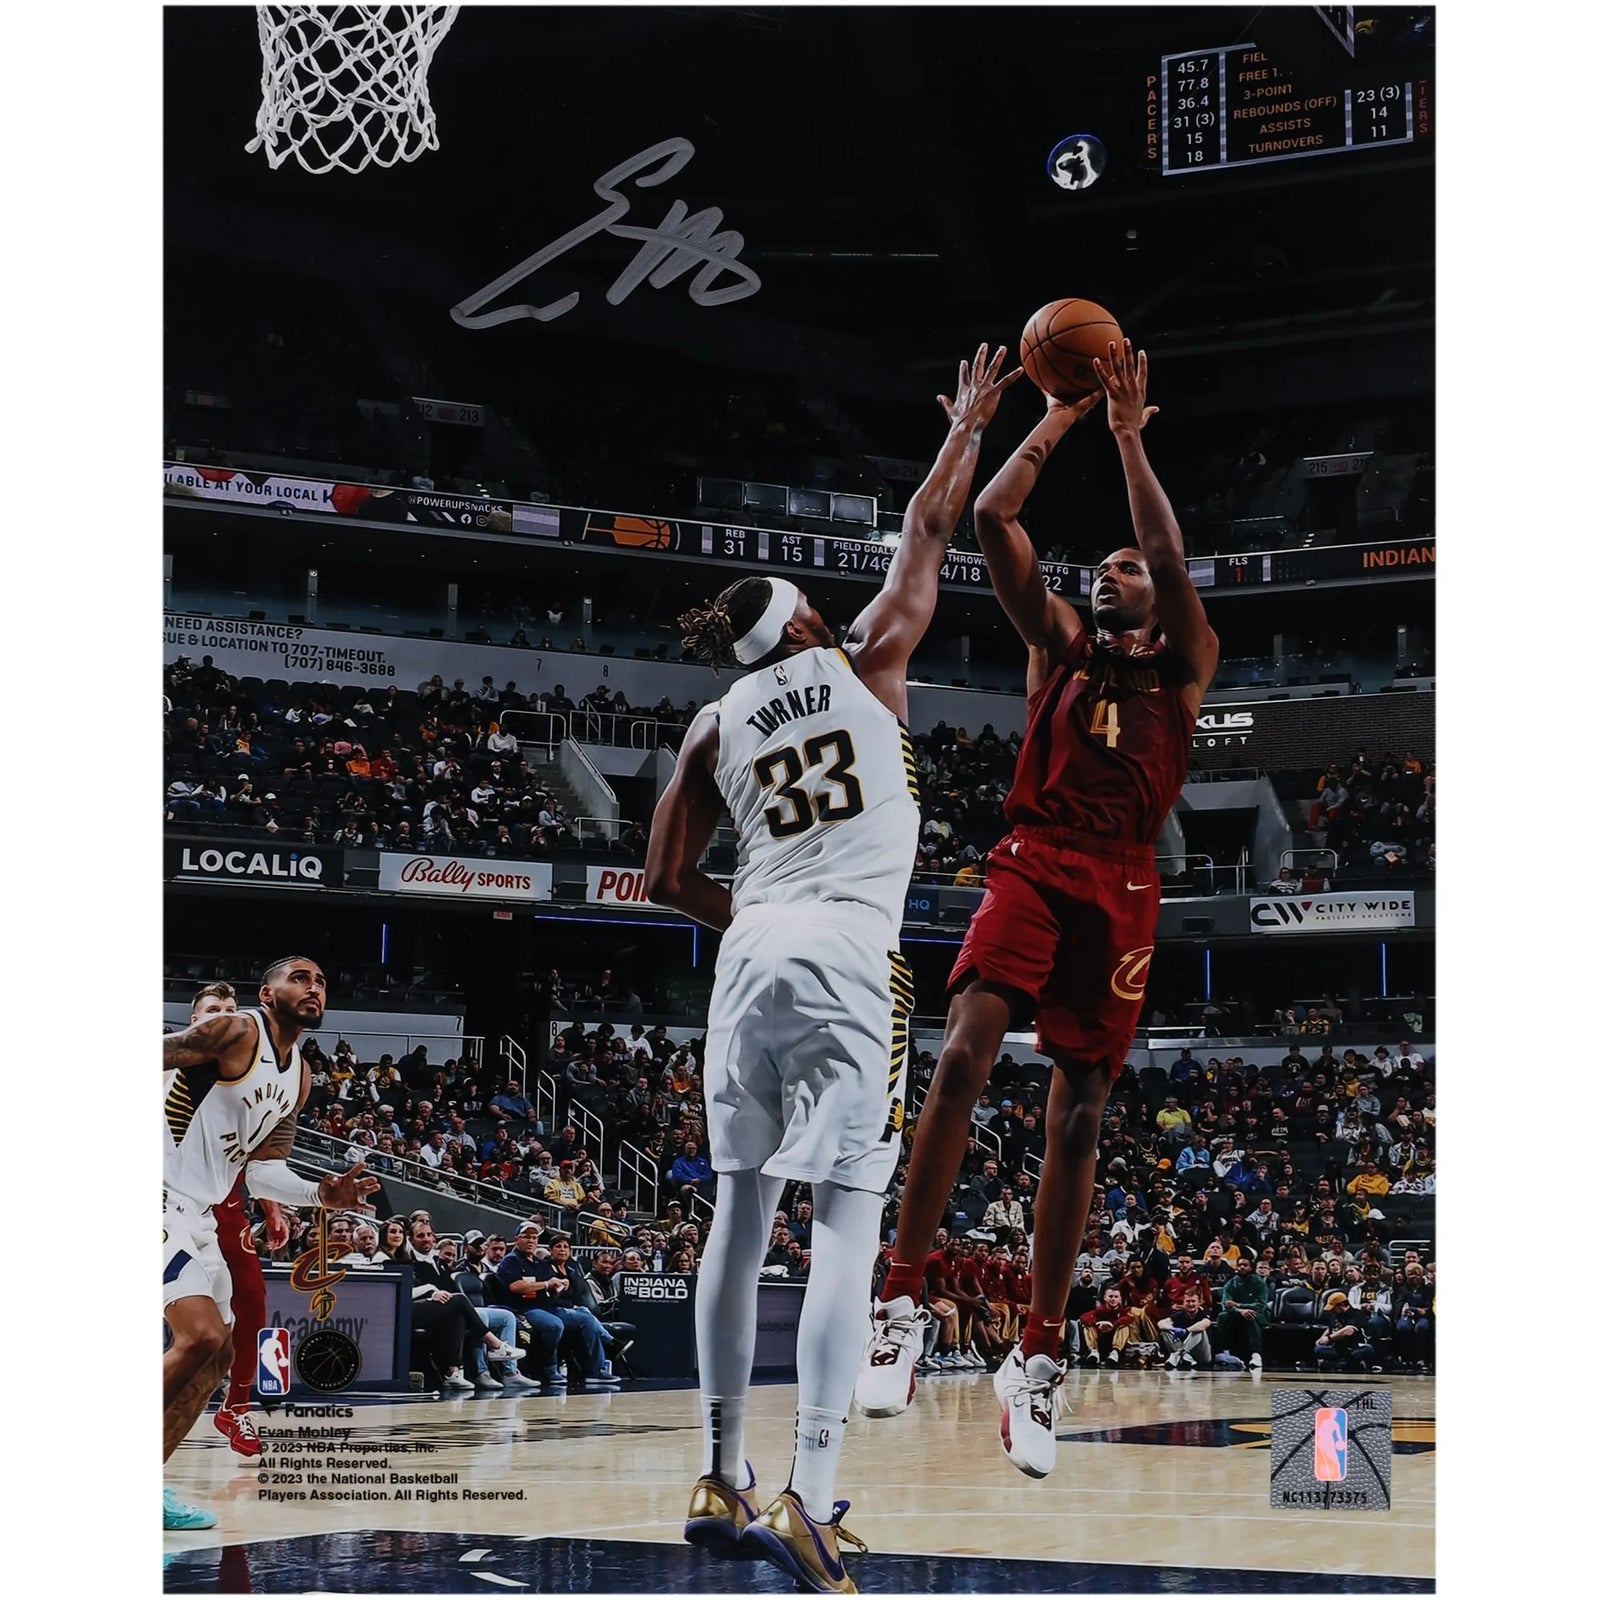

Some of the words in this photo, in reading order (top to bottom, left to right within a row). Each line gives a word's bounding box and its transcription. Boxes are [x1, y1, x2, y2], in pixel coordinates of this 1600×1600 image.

[1177, 59, 1209, 74] 45.7
[1239, 69, 1269, 82] FREE
[1177, 77, 1209, 91] 77.8
[1357, 90, 1376, 103] 23
[1380, 85, 1400, 101] (3)
[1177, 96, 1209, 110] 36.4
[1233, 101, 1301, 119] REBOUNDS
[1304, 96, 1337, 112] (OFF)
[1146, 75, 1157, 159] PACERS
[1173, 117, 1191, 128] 31
[1195, 112, 1215, 127] (3)
[1370, 106, 1388, 119] 14
[1259, 118, 1312, 134] ASSISTS
[1370, 125, 1387, 138] 11
[1186, 132, 1203, 145] 15
[1248, 135, 1323, 153] TURNOVERS
[1186, 151, 1203, 163] 18
[215, 481, 231, 491] AT
[236, 482, 272, 496] YOUR
[276, 487, 318, 501] LOCAL
[725, 528, 746, 539] REB
[782, 535, 801, 545] AST
[724, 540, 745, 556] 31
[782, 546, 803, 562] 15
[833, 541, 861, 551] FIELD
[863, 543, 896, 555] GOALS
[838, 552, 890, 572] 21/46
[1229, 556, 1248, 566] FLS
[1056, 566, 1069, 575] FG
[165, 616, 203, 631] NEED
[205, 620, 303, 639] ASSISTANCE?
[188, 633, 199, 646] &
[202, 635, 269, 652] LOCATION
[271, 641, 289, 654] TO
[291, 642, 386, 663] 707-TIMEOUT.
[284, 653, 323, 671] (707)
[326, 661, 396, 677] 846-3688
[746, 684, 832, 738] TURNER
[1089, 699, 1121, 748] 4
[1192, 736, 1248, 748] LOFT
[753, 729, 865, 840] 33
[400, 857, 476, 893] Bally
[477, 871, 531, 890] SPORTS
[908, 898, 931, 911] HQ
[1315, 902, 1357, 914] CITY
[1364, 900, 1411, 911] WIDE
[551, 1021, 558, 1036] 8
[624, 1277, 687, 1288] INDIANA
[638, 1287, 689, 1300] BOLD
